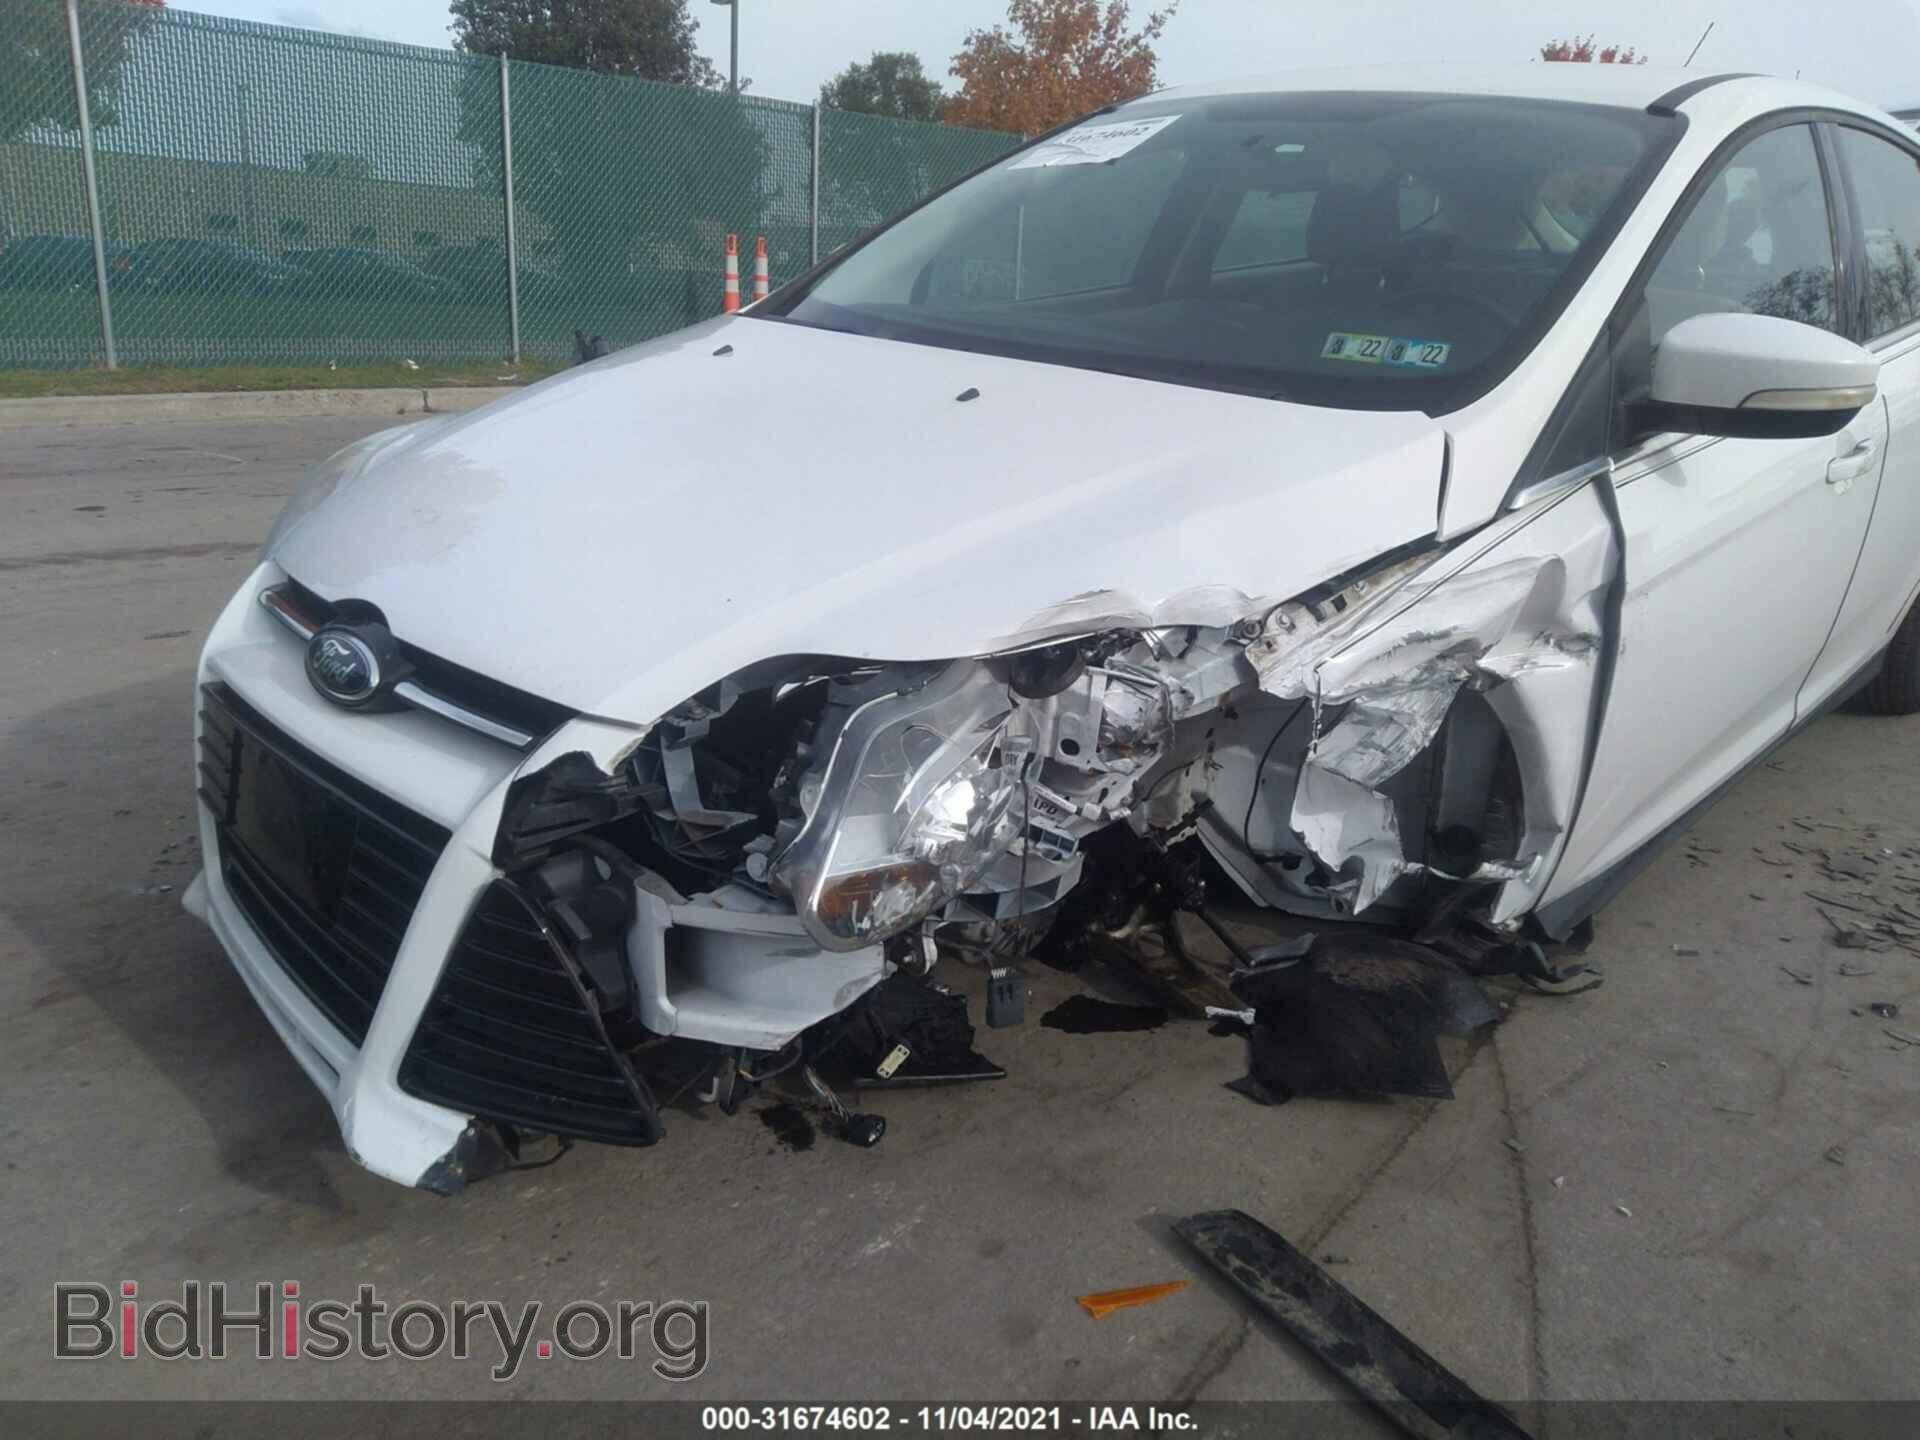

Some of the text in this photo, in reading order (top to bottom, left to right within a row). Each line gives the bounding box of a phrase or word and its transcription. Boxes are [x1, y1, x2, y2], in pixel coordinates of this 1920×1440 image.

[1360, 339, 1382, 358] 22
[1421, 344, 1444, 364] 22
[317, 639, 357, 685] Ford
